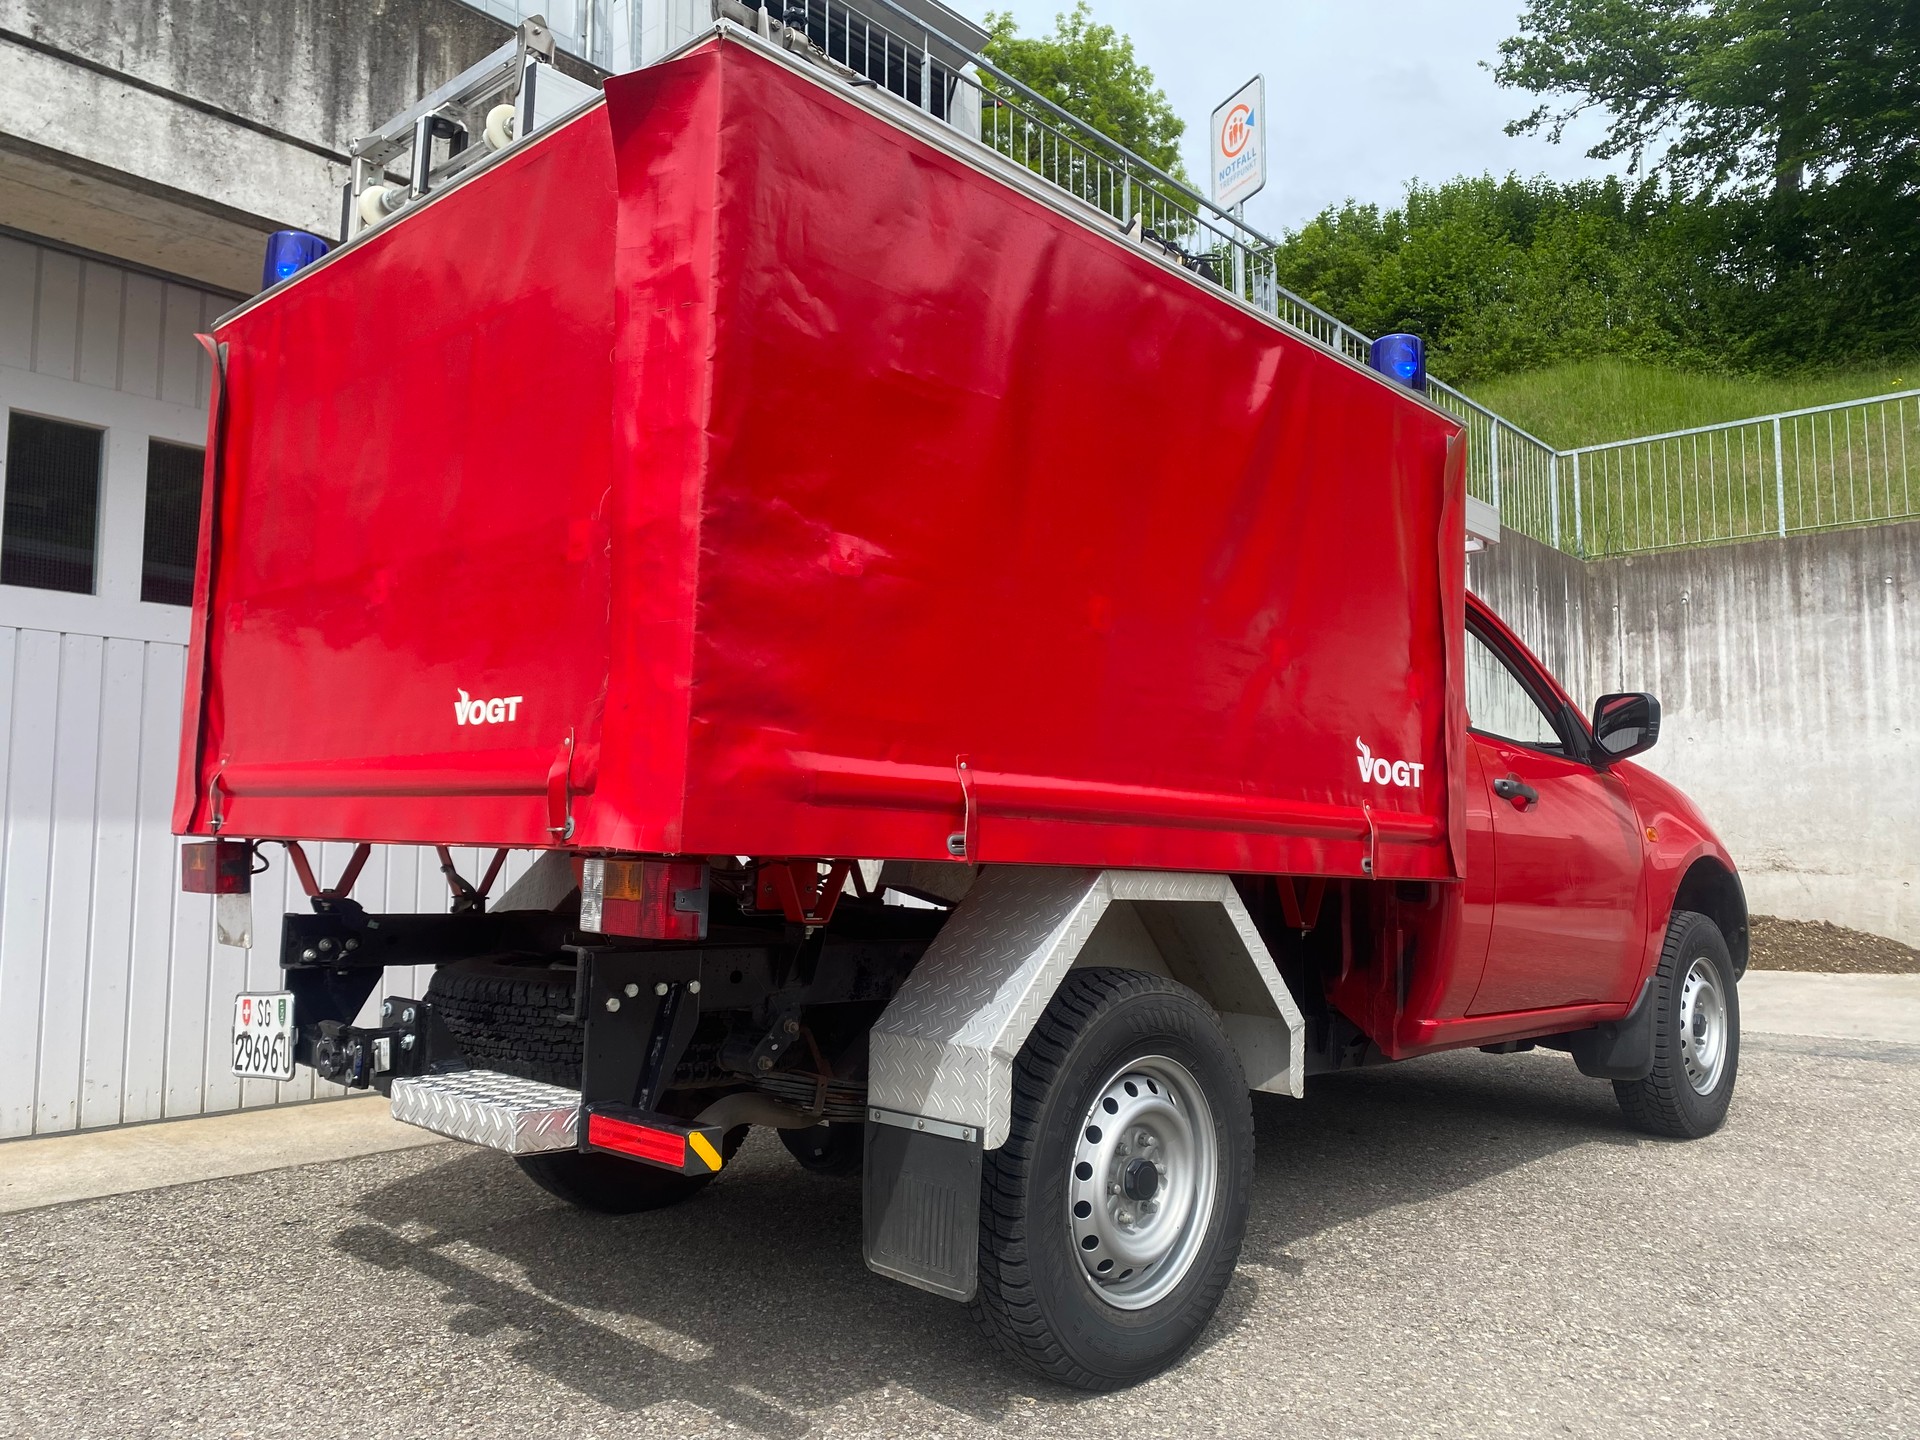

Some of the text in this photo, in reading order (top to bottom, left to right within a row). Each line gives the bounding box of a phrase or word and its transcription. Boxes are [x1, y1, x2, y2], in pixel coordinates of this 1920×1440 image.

[1219, 147, 1257, 182] NOTFALL
[454, 692, 523, 726] VOGT
[1356, 753, 1425, 788] VOGT
[257, 999, 271, 1027] SG
